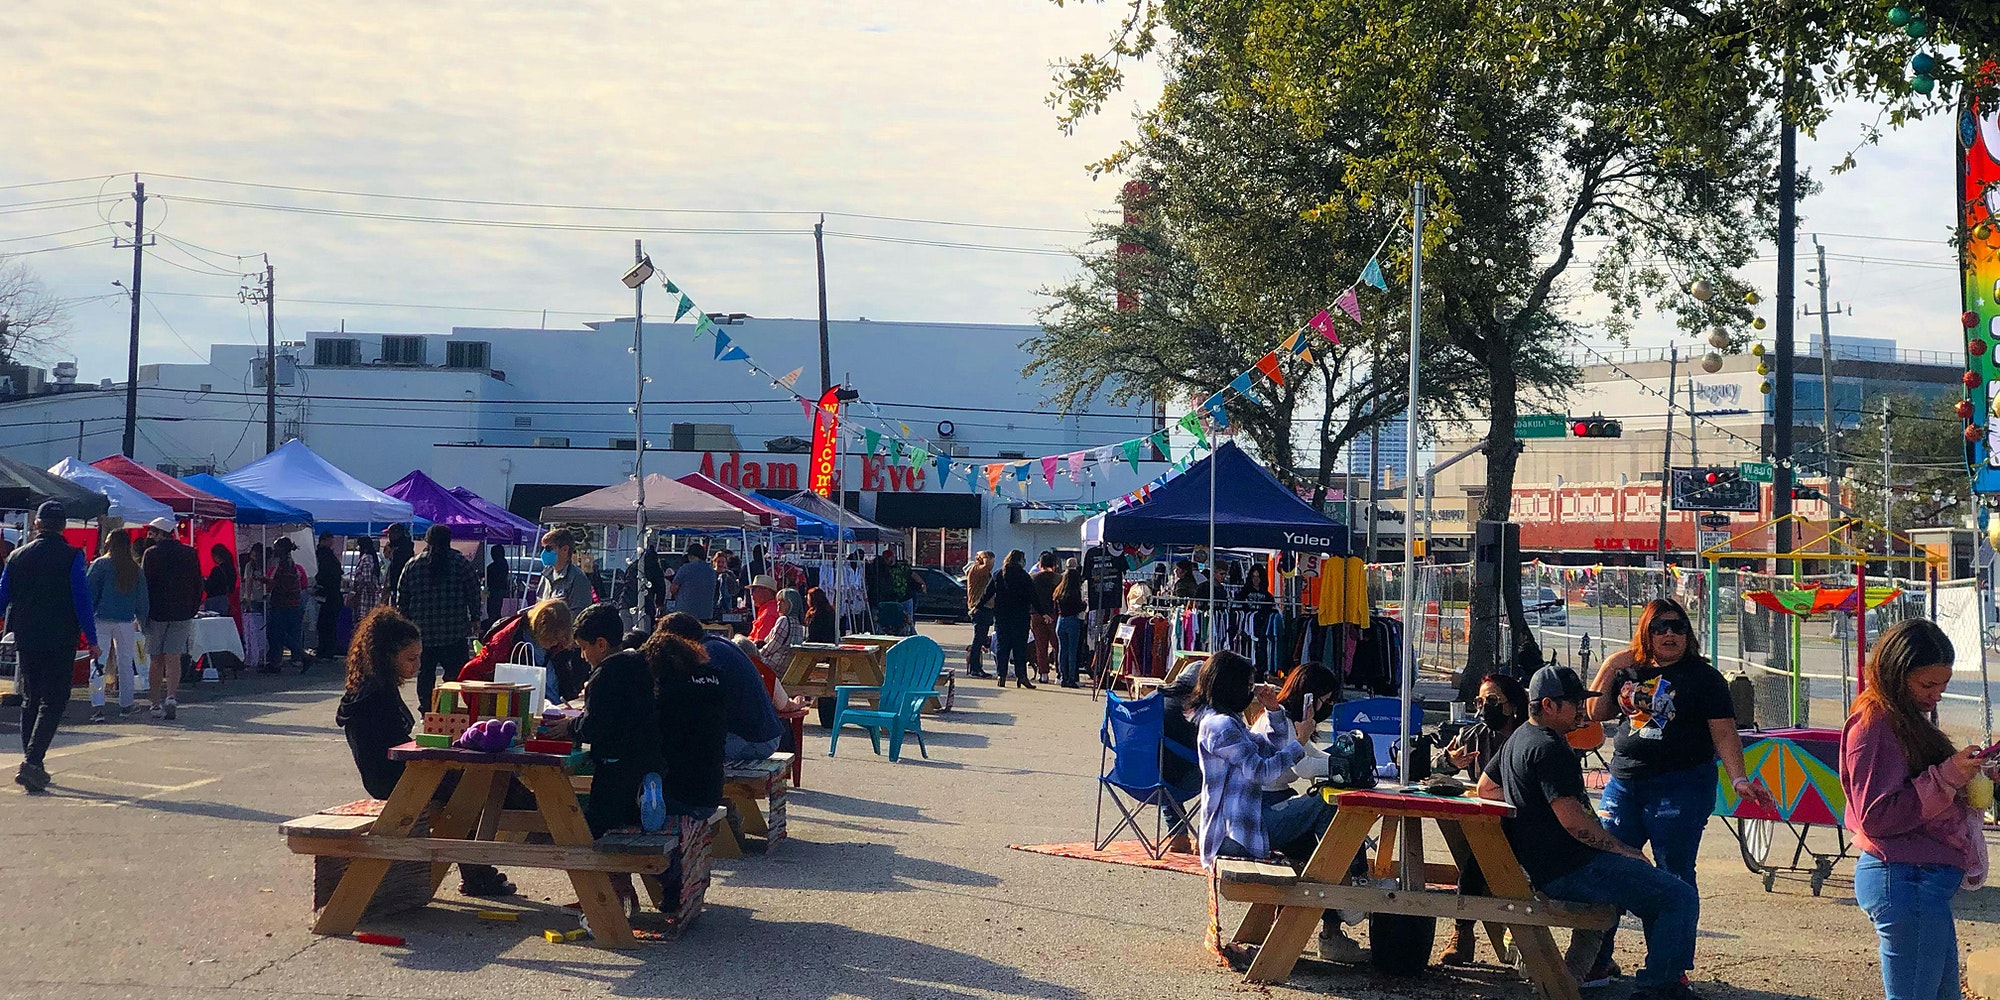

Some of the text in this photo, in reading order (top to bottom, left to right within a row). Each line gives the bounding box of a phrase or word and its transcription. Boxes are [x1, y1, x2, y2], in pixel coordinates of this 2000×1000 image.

[699, 452, 797, 489] Adam
[860, 455, 925, 491] Eve
[1743, 464, 1773, 479] Waug
[1283, 531, 1330, 547] Yoleo
